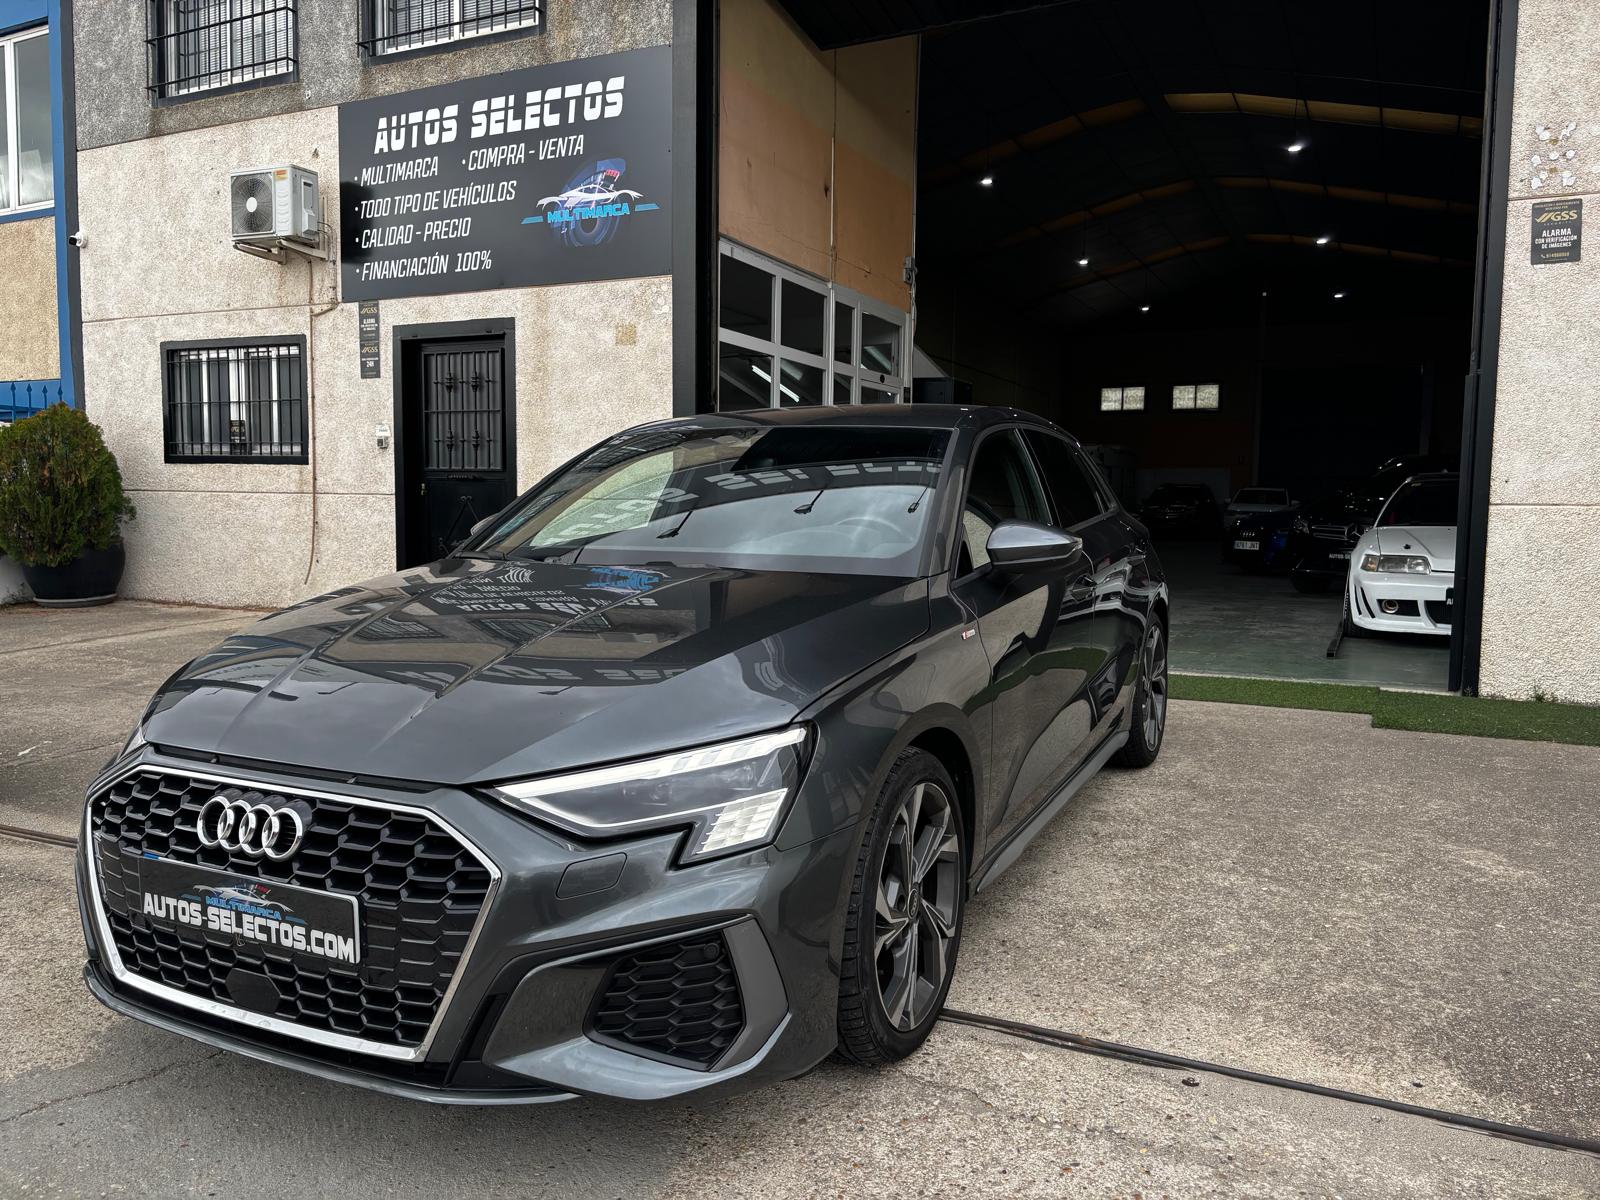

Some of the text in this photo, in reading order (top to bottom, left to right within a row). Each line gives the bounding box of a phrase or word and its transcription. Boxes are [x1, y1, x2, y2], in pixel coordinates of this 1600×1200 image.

[374, 76, 625, 154] AUTOS SELECTOS
[468, 143, 525, 171] COMPRA
[538, 134, 584, 161] VENTA
[360, 156, 439, 187] MULTIMARCA
[360, 180, 517, 219] TODO TIPO DE VEHÍCULOS
[547, 202, 630, 223] MULTIMARCA
[361, 224, 414, 249] CALIDAD
[423, 217, 471, 242] PRECIO
[1542, 228, 1572, 237] ALARMA
[361, 250, 492, 281] FINANCIACIÓN 100%
[205, 895, 282, 920] MULTIMARCA
[143, 892, 355, 964] AUTOS-SELECTOS.COM
